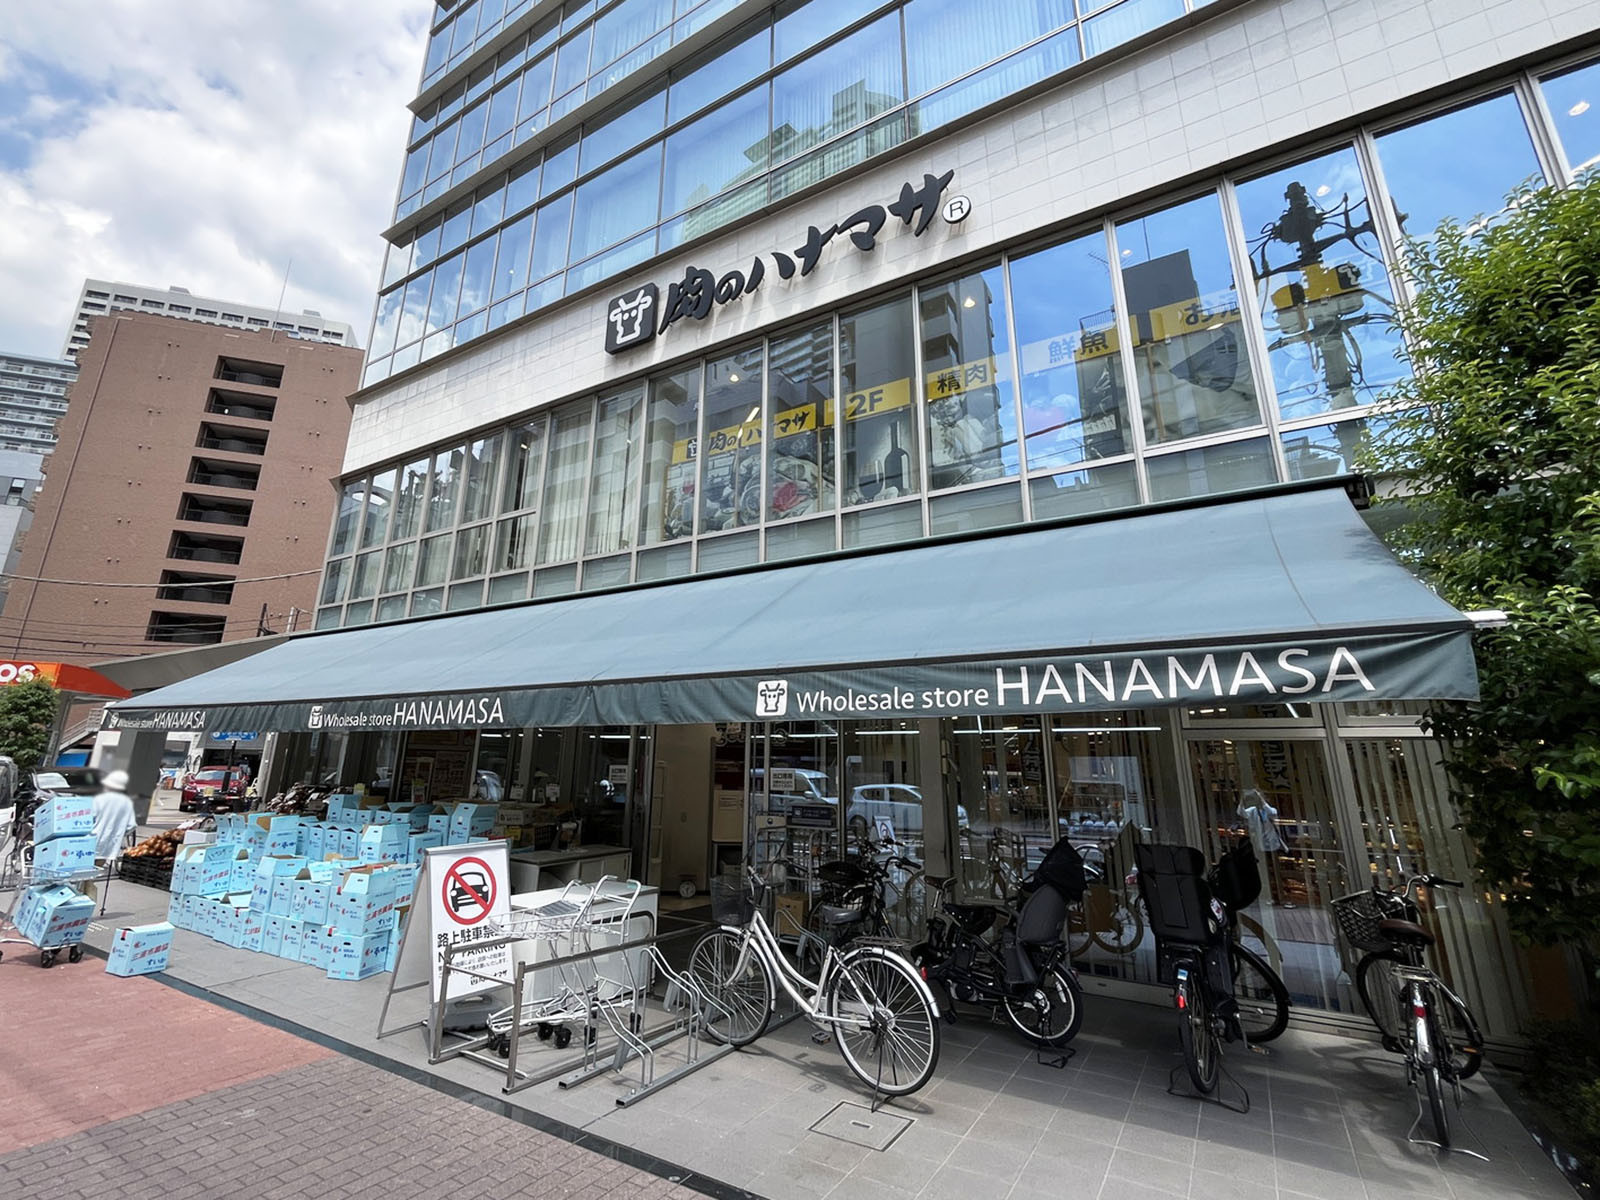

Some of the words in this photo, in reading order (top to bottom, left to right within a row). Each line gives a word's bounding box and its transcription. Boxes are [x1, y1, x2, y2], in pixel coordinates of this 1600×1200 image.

[658, 168, 954, 336] 肉のハナマサ
[1048, 330, 1109, 364] 鮮魚
[936, 363, 988, 394] 精肉
[848, 389, 884, 418] 2F
[797, 690, 915, 714] Wholesale
[921, 684, 990, 708] store
[996, 646, 1376, 706] HANAMASA
[152, 711, 206, 729] HANAMASA
[323, 712, 367, 727] Wholesale
[368, 711, 391, 726] store
[393, 697, 504, 726] HANAMASA
[437, 925, 504, 948] 路上駐車禁
